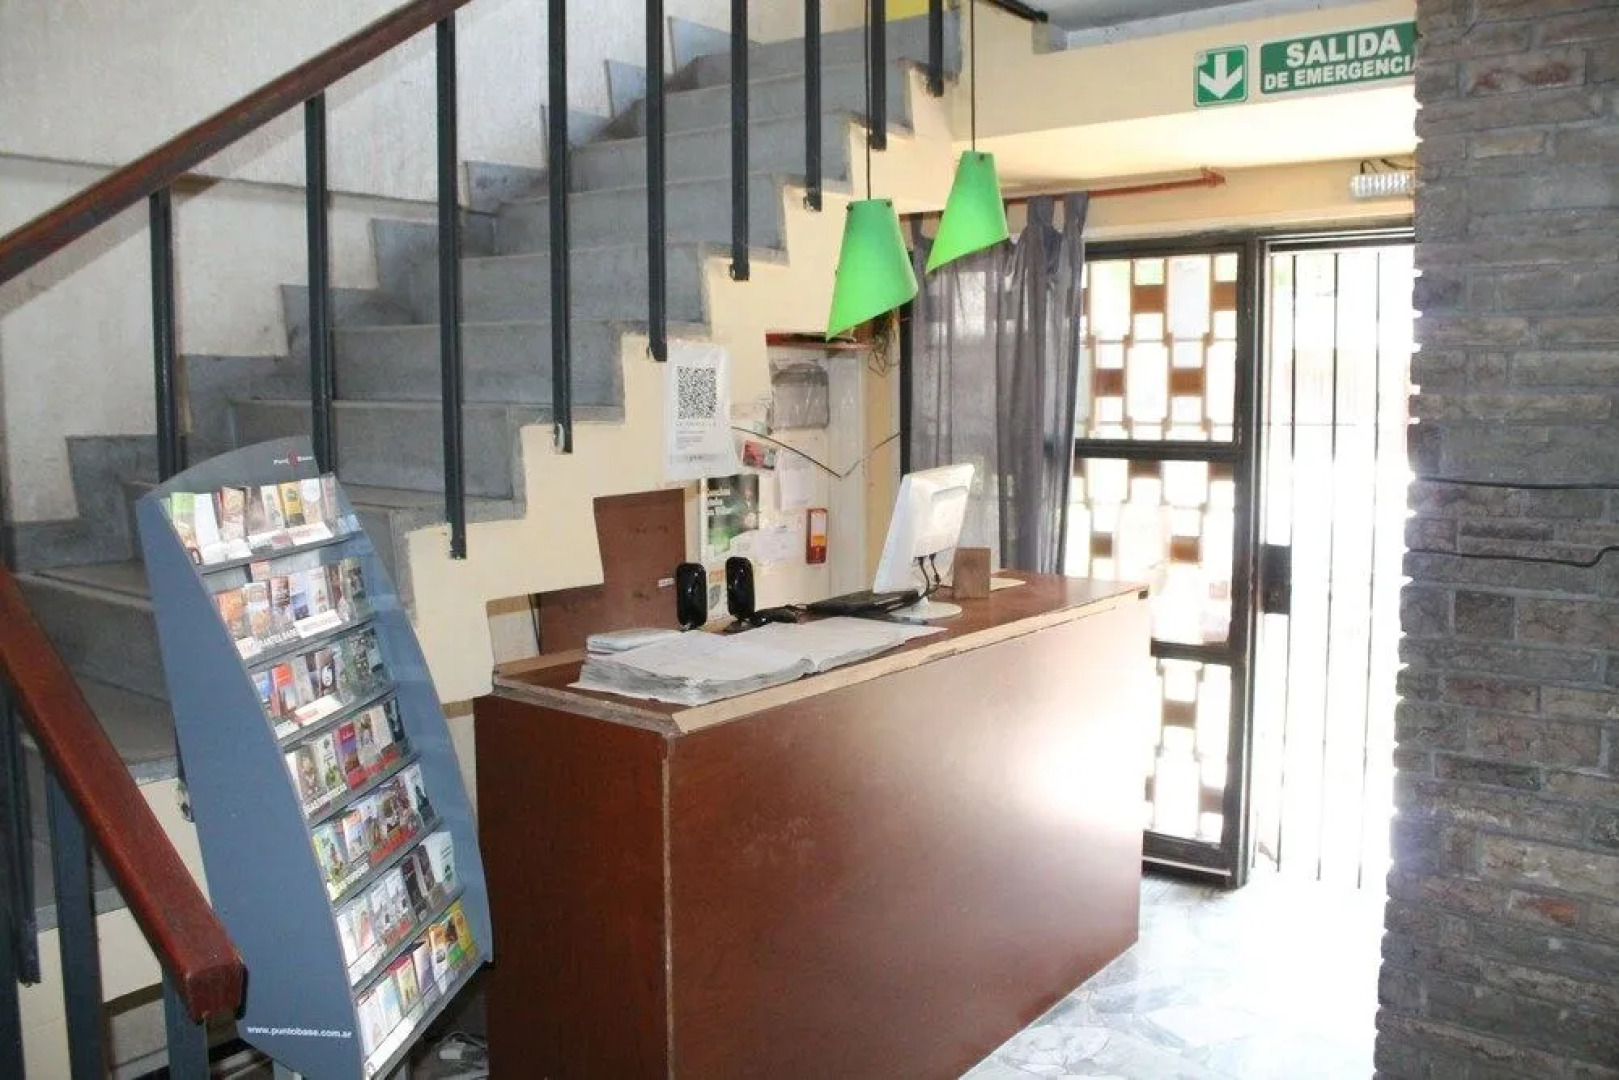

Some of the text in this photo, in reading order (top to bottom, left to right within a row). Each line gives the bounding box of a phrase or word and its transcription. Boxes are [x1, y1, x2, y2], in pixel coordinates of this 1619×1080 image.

[1286, 29, 1401, 68] SALIDA
[1265, 56, 1416, 90] DE EMERGENCI
[247, 1026, 352, 1039] www.puntobase.com.ar
